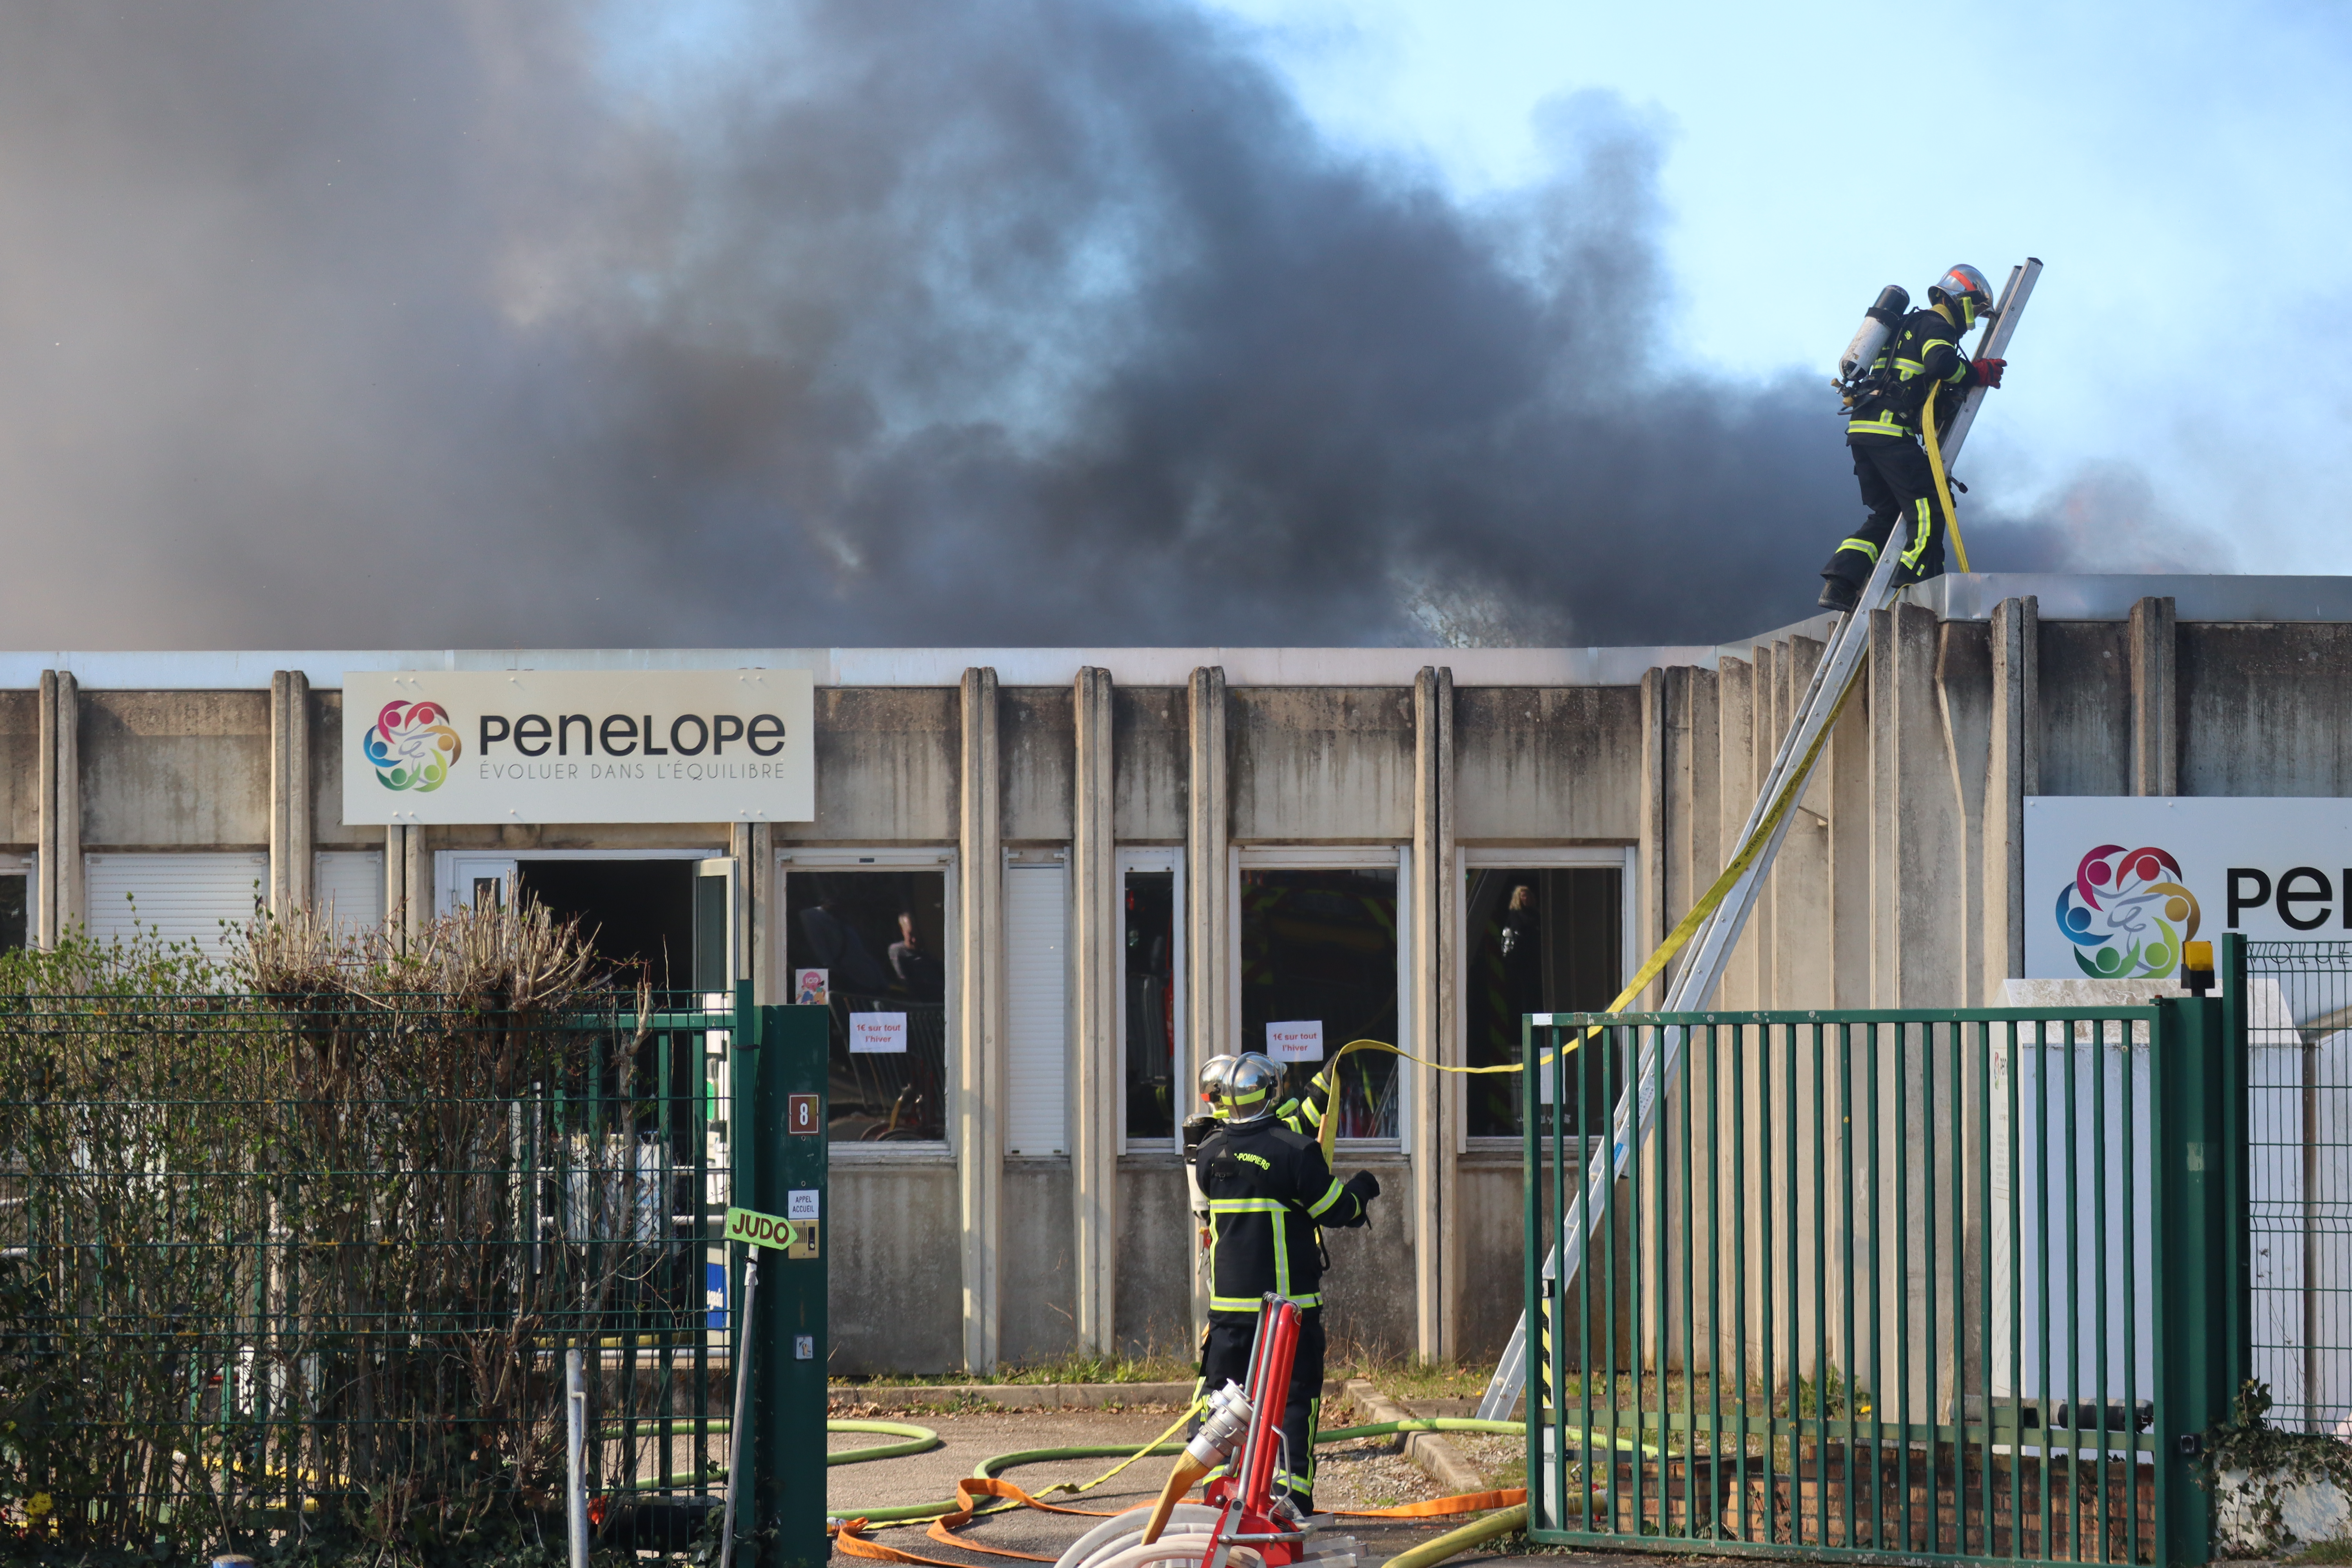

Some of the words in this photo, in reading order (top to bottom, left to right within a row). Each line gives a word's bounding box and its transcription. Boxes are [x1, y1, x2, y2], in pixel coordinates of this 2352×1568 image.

[480, 760, 578, 779] ÉVOLUER
[592, 764, 645, 779] DANS
[658, 760, 784, 780] L'ÉQUILIBRE
[2227, 867, 2352, 930] Pe
[800, 1103, 808, 1125] 8
[733, 1213, 789, 1244] JUDO
